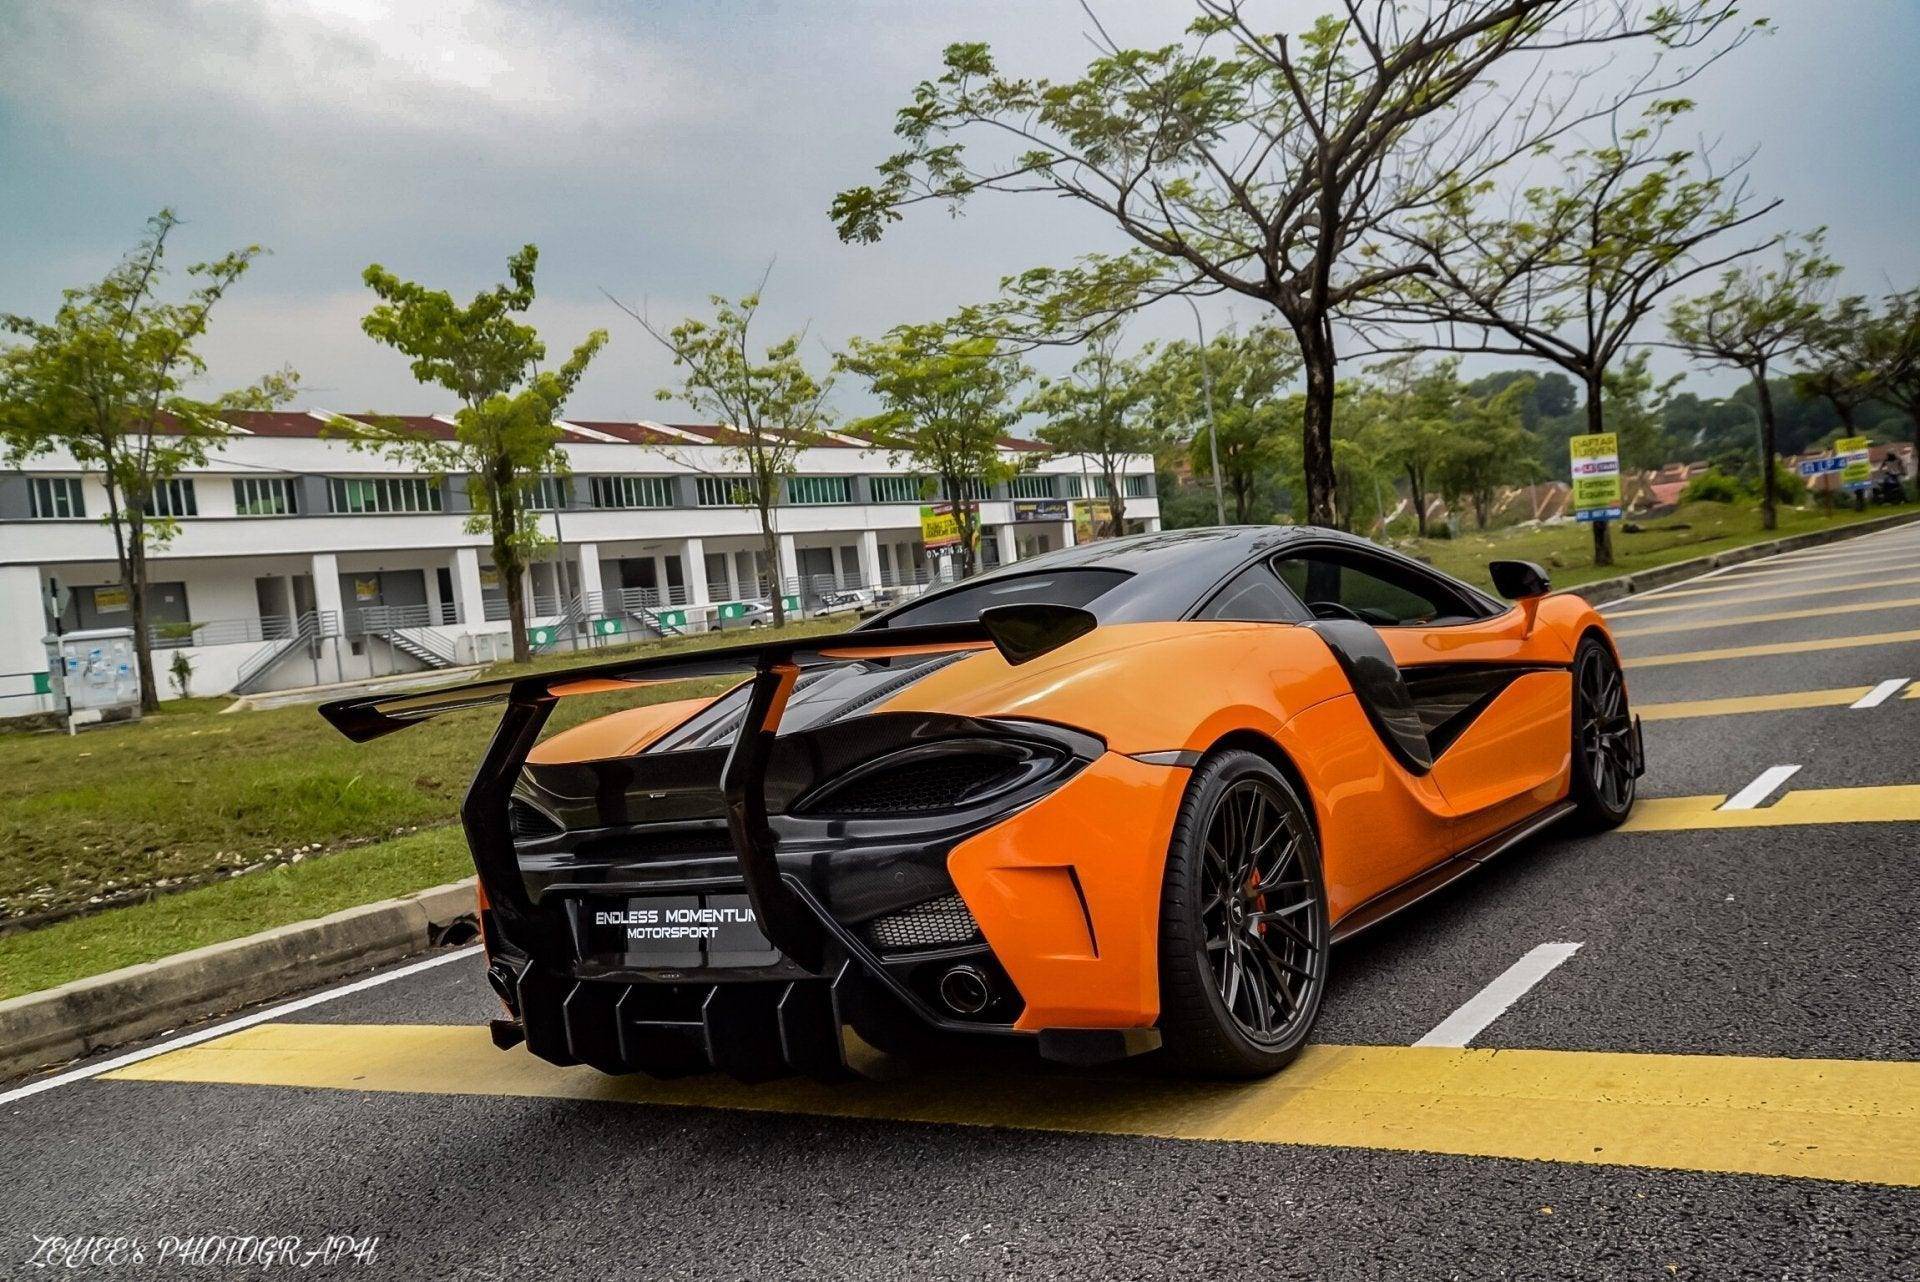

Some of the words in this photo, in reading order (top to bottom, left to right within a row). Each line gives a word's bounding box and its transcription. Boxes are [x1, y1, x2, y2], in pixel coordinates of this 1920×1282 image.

[1577, 479, 1616, 489] Taman
[1578, 489, 1616, 499] Equine
[596, 910, 658, 924] ENDLESS
[627, 926, 719, 939] MOTORSPORT
